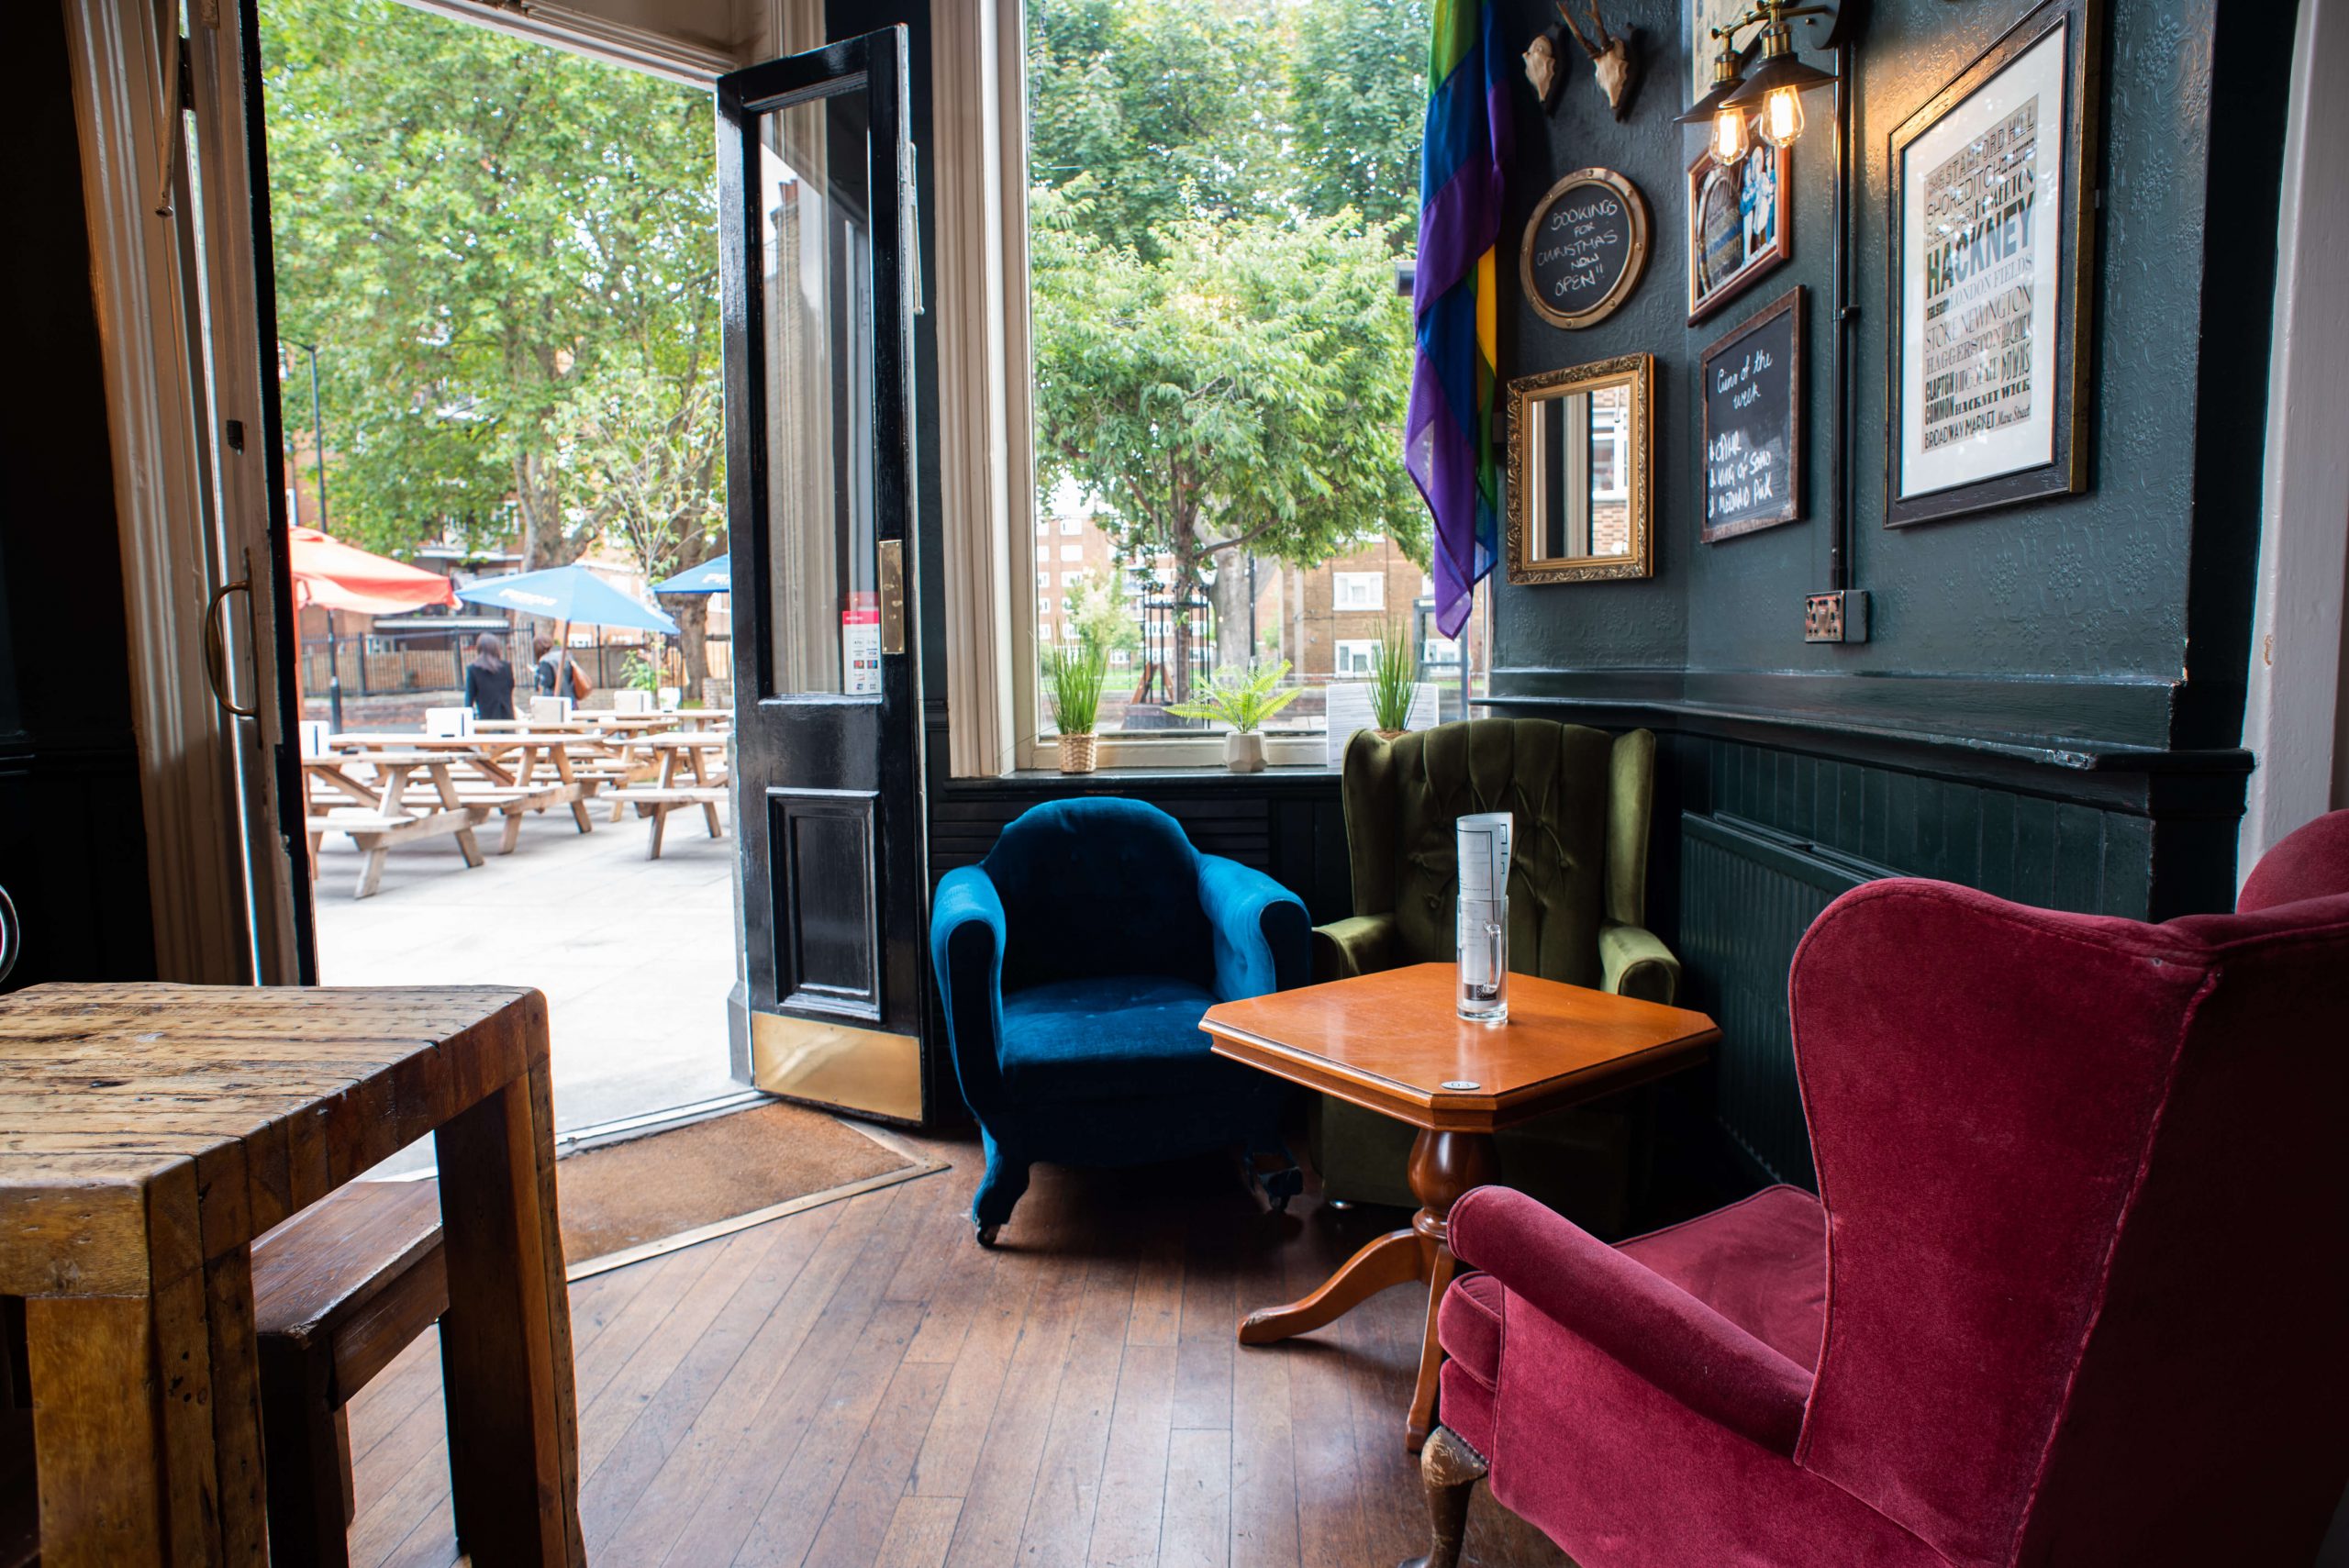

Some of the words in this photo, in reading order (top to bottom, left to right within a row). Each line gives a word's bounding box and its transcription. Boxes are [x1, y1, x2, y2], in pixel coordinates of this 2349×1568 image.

[2008, 106, 2034, 145] HILL
[1927, 157, 2001, 226] SHOREDITCH
[1975, 167, 2033, 220] HOMERTON
[1551, 199, 1618, 231] BOOKINGS
[1574, 222, 1595, 238] FOR
[1537, 229, 1618, 266] CHRISTMAS
[1571, 252, 1600, 271] NOW
[1927, 190, 2034, 299] HACKNEY
[1949, 274, 1992, 309] LONDON
[1994, 253, 2032, 287] FIELDS
[1926, 318, 1958, 352] STOKE
[1960, 284, 2032, 334] NEWINGTON
[1741, 355, 1750, 381] of
[1753, 350, 1773, 374] the
[1926, 327, 2000, 375] HAGGERSTON
[1926, 371, 1954, 403] CLAPTON
[2000, 341, 2031, 384] DOWNS
[1733, 382, 1762, 409] week
[1925, 395, 1954, 426] COMMON
[1954, 390, 1999, 416] HACKNEY
[2000, 378, 2030, 399] WICK
[1925, 420, 1964, 450] BROADWAY
[1965, 410, 1995, 437] MARKET
